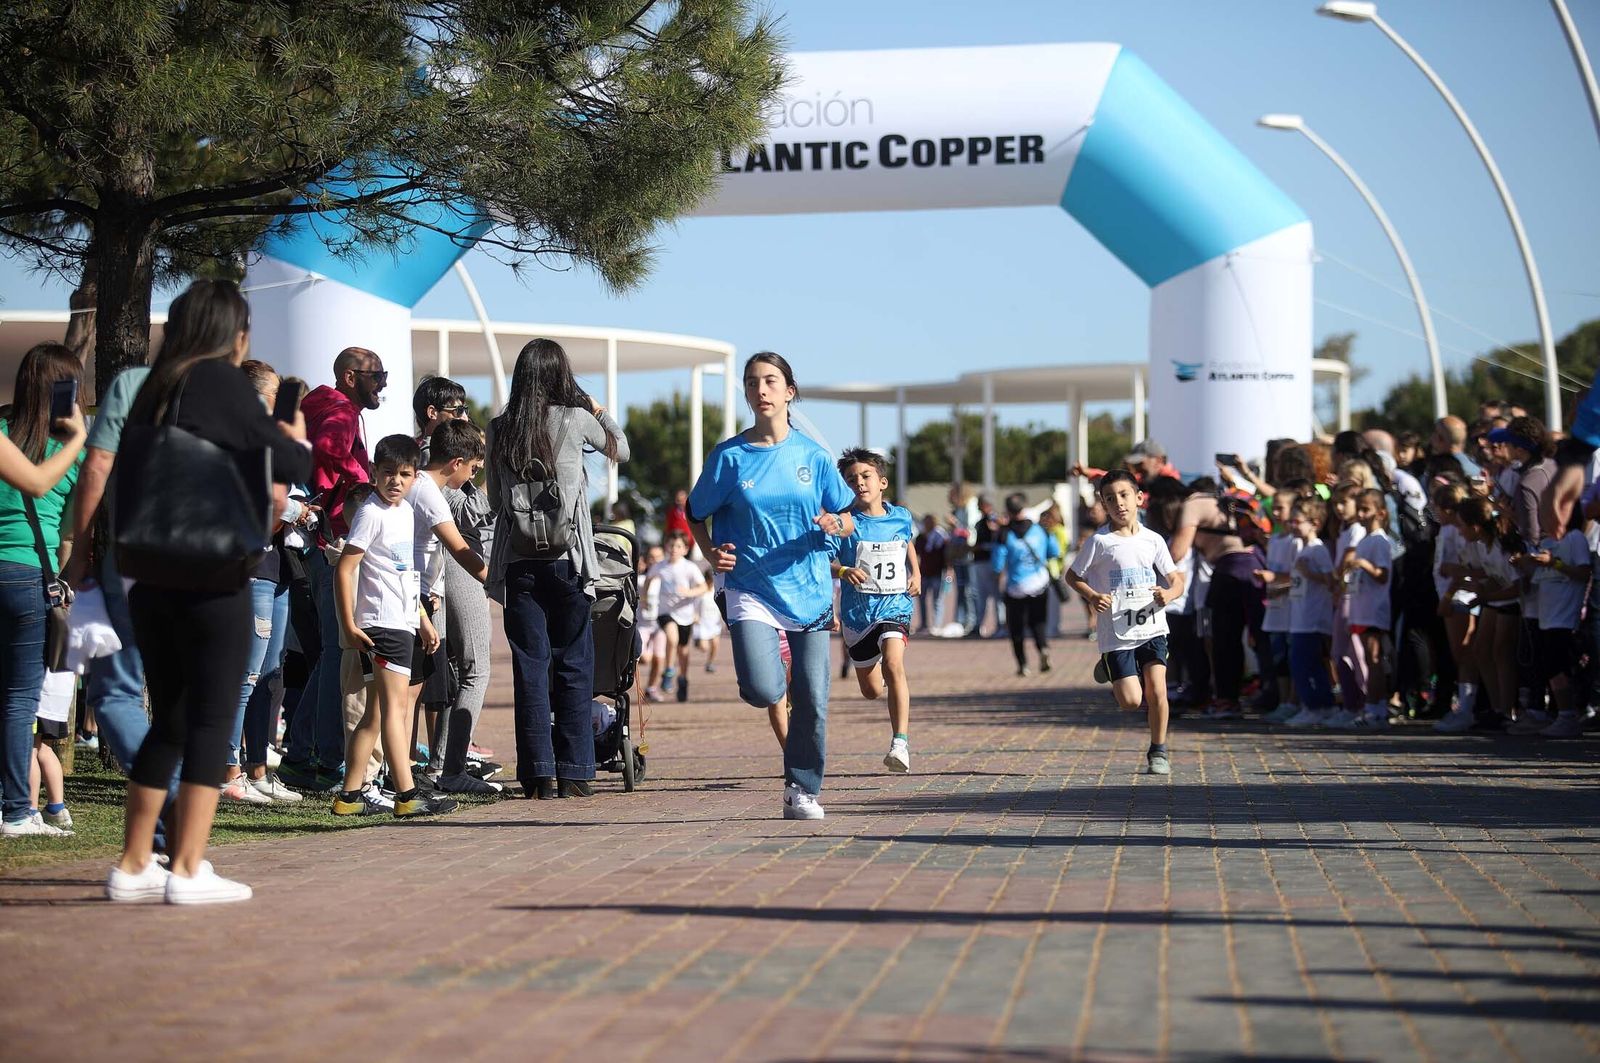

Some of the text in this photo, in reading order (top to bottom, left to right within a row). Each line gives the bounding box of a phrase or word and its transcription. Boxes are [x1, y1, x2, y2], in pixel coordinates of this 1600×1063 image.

[768, 90, 874, 128] ación
[719, 134, 1045, 173] LANTIC COPPER
[874, 562, 896, 580] 13
[1123, 607, 1156, 626] 161
